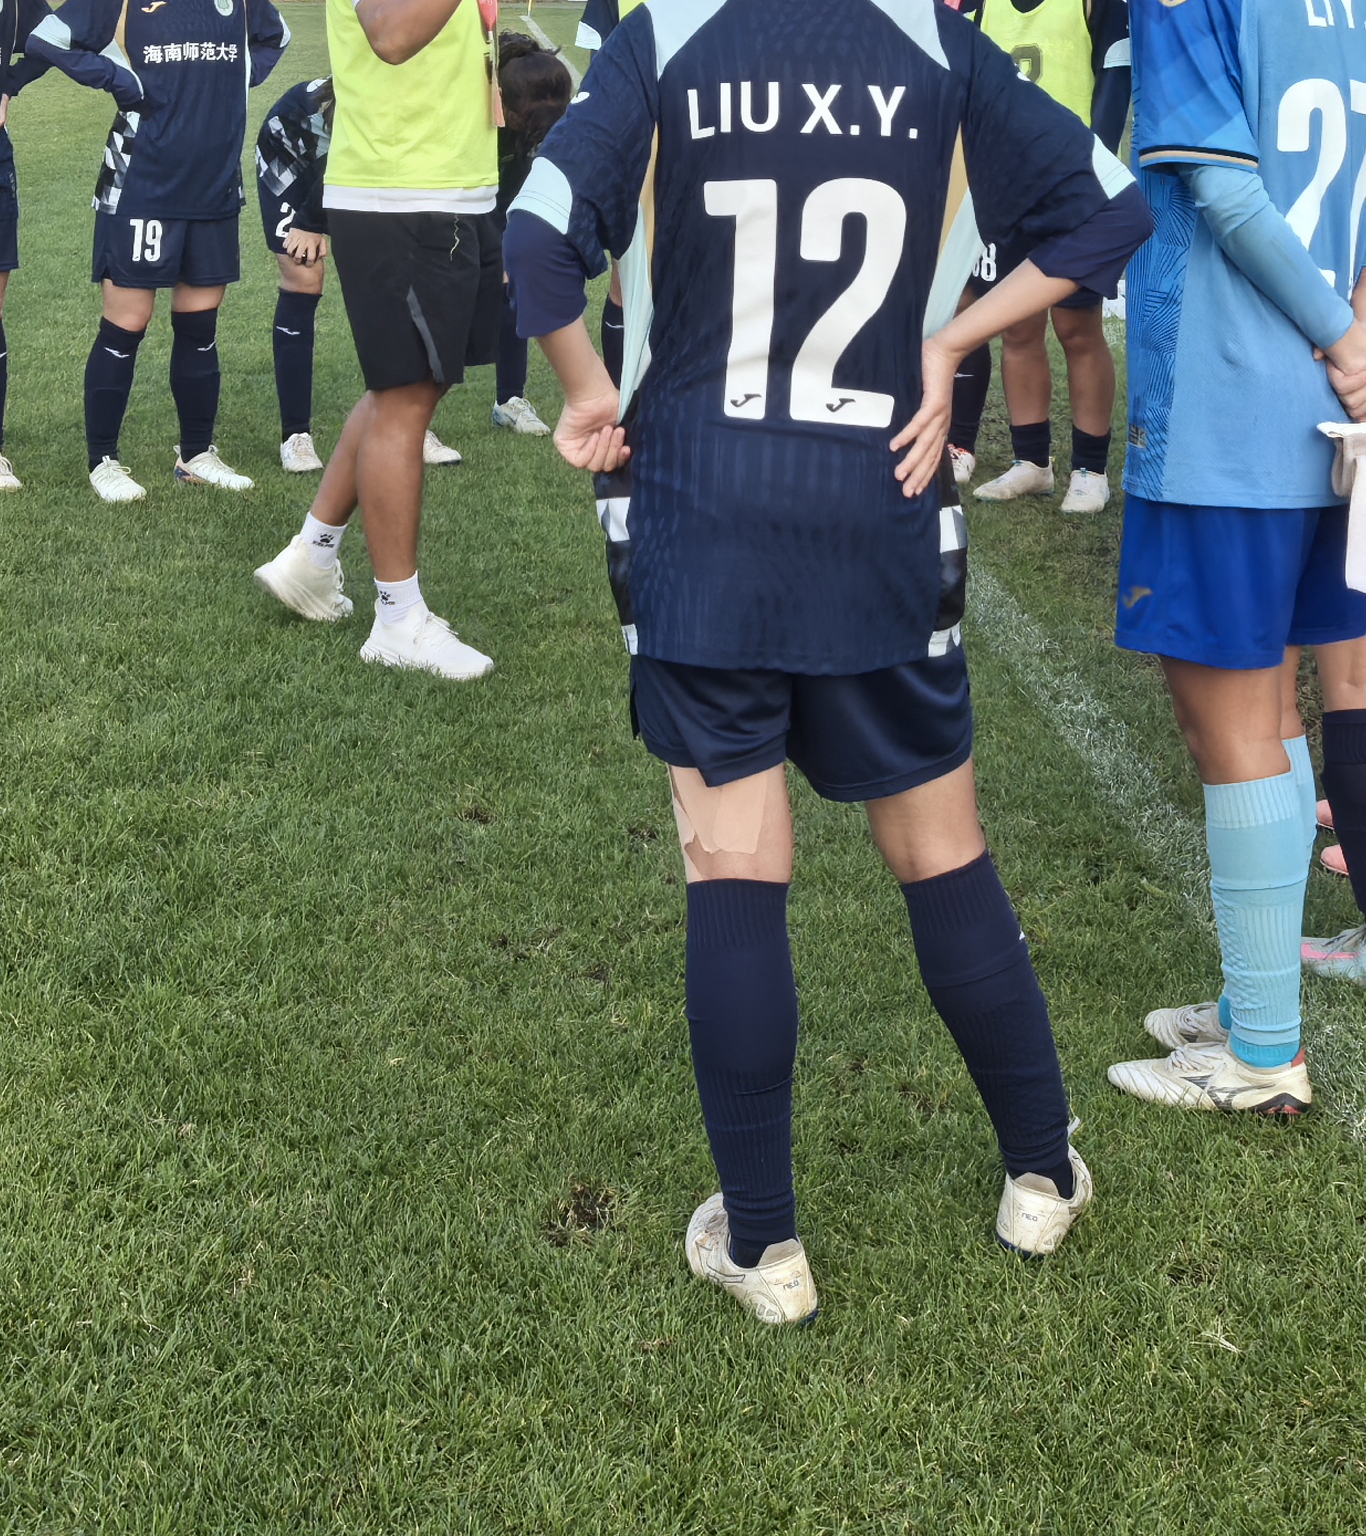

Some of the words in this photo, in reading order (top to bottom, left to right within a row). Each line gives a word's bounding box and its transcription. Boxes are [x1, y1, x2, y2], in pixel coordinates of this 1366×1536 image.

[143, 42, 238, 64] 海南师范大学
[687, 82, 780, 139] LIU
[801, 84, 919, 139] X.Y.
[130, 219, 162, 261] 19
[703, 177, 907, 428] 12
